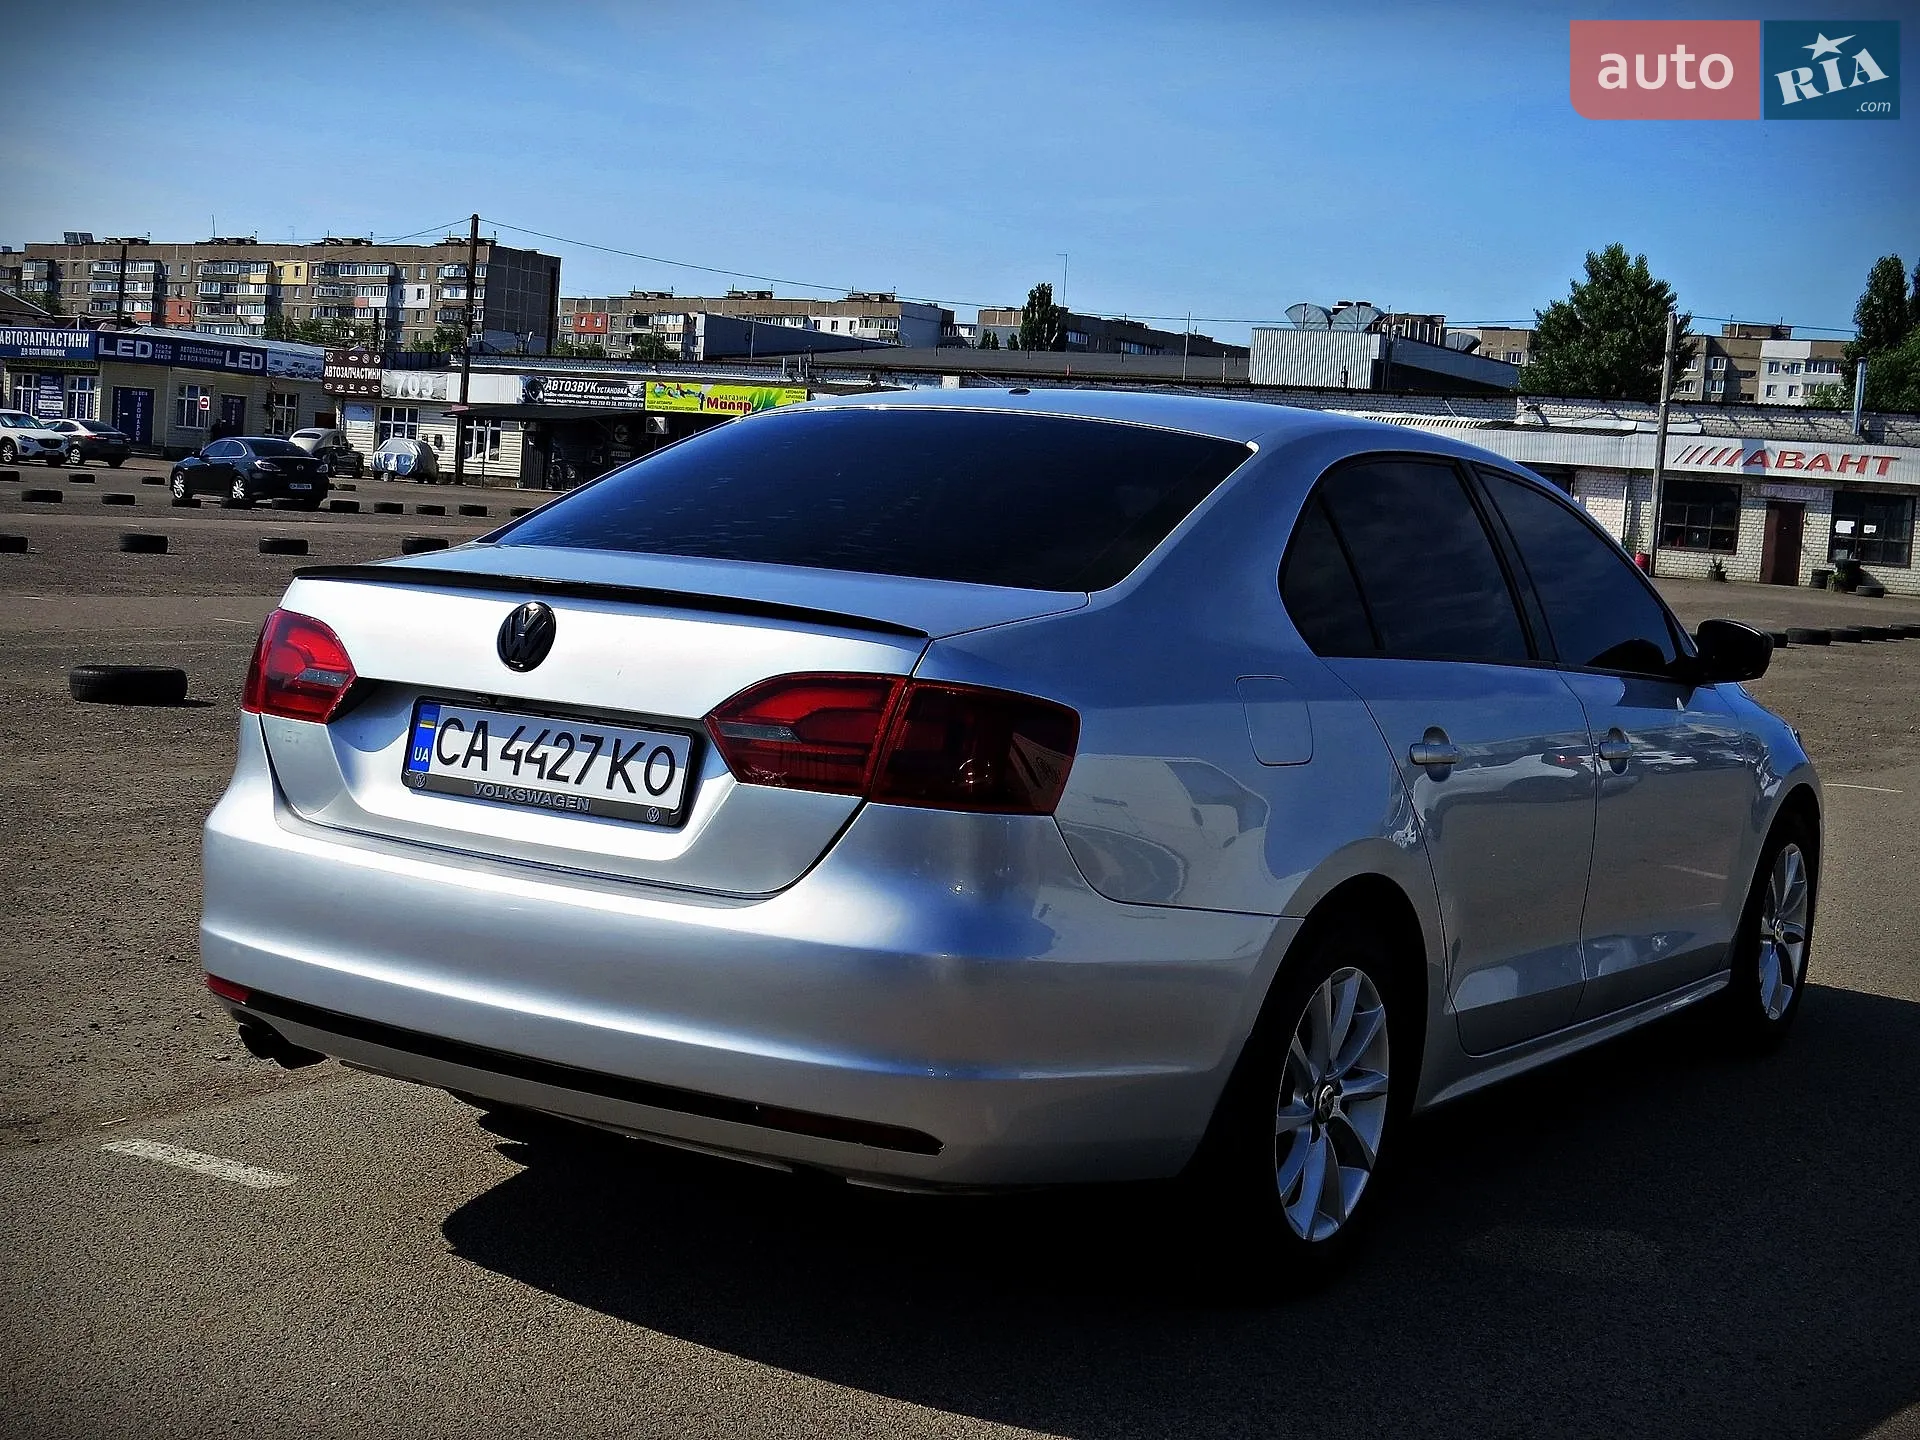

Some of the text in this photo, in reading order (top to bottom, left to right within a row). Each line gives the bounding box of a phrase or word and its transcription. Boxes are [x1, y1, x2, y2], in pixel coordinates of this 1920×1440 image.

[0, 331, 90, 348] АВТОЗАПЧАСТИНИ
[98, 337, 153, 358] LED
[225, 350, 263, 370] LED
[324, 365, 381, 381] АВТОЗАПЧАСТИНИ
[545, 379, 598, 393] АВТОЗВУК
[1741, 449, 1901, 476] АВАНТ
[413, 746, 430, 763] UA
[436, 717, 676, 797] CA 4427 KO
[473, 782, 591, 812] VOLKSWAGEN
